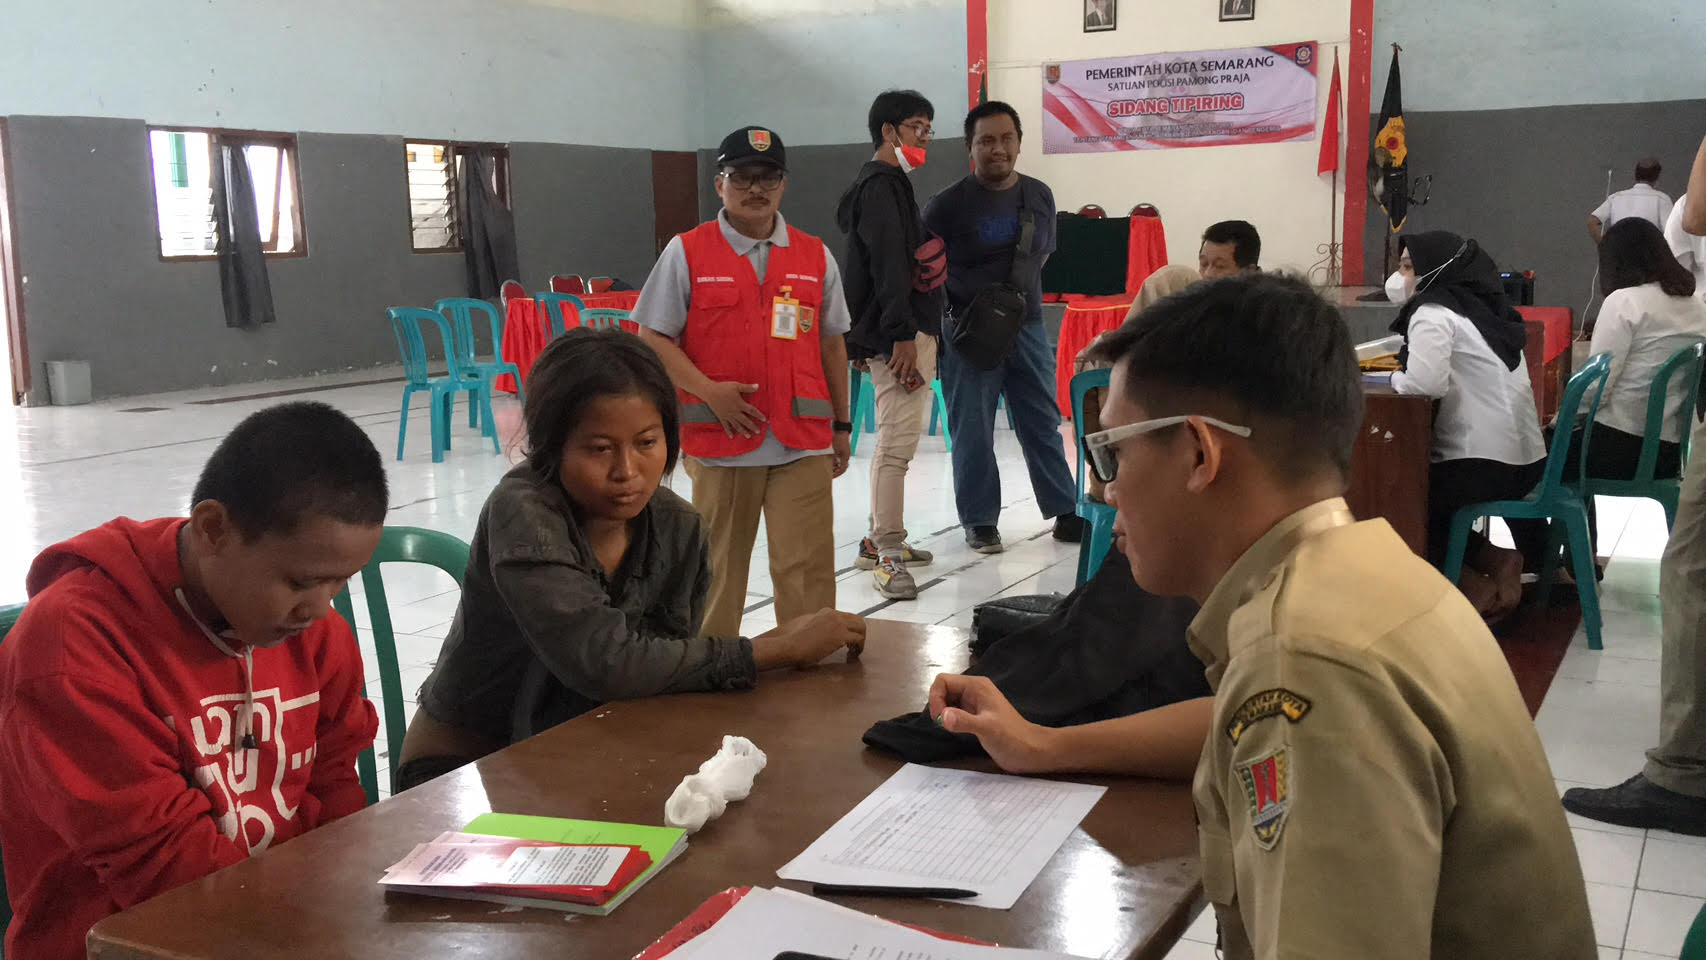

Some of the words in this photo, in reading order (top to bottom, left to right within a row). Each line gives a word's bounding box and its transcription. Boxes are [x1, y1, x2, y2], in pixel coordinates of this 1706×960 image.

[1086, 63, 1162, 80] PEMERINTAH
[1165, 62, 1198, 74] KOTA
[1201, 56, 1274, 72] SEMARANG
[1108, 81, 1146, 92] SATUAN
[1147, 79, 1175, 88] POLISI
[1176, 75, 1219, 87] PAMONG
[1220, 73, 1250, 83] PRAJA
[1108, 99, 1170, 117] SIDANG
[1171, 93, 1244, 112] TIPIRING
